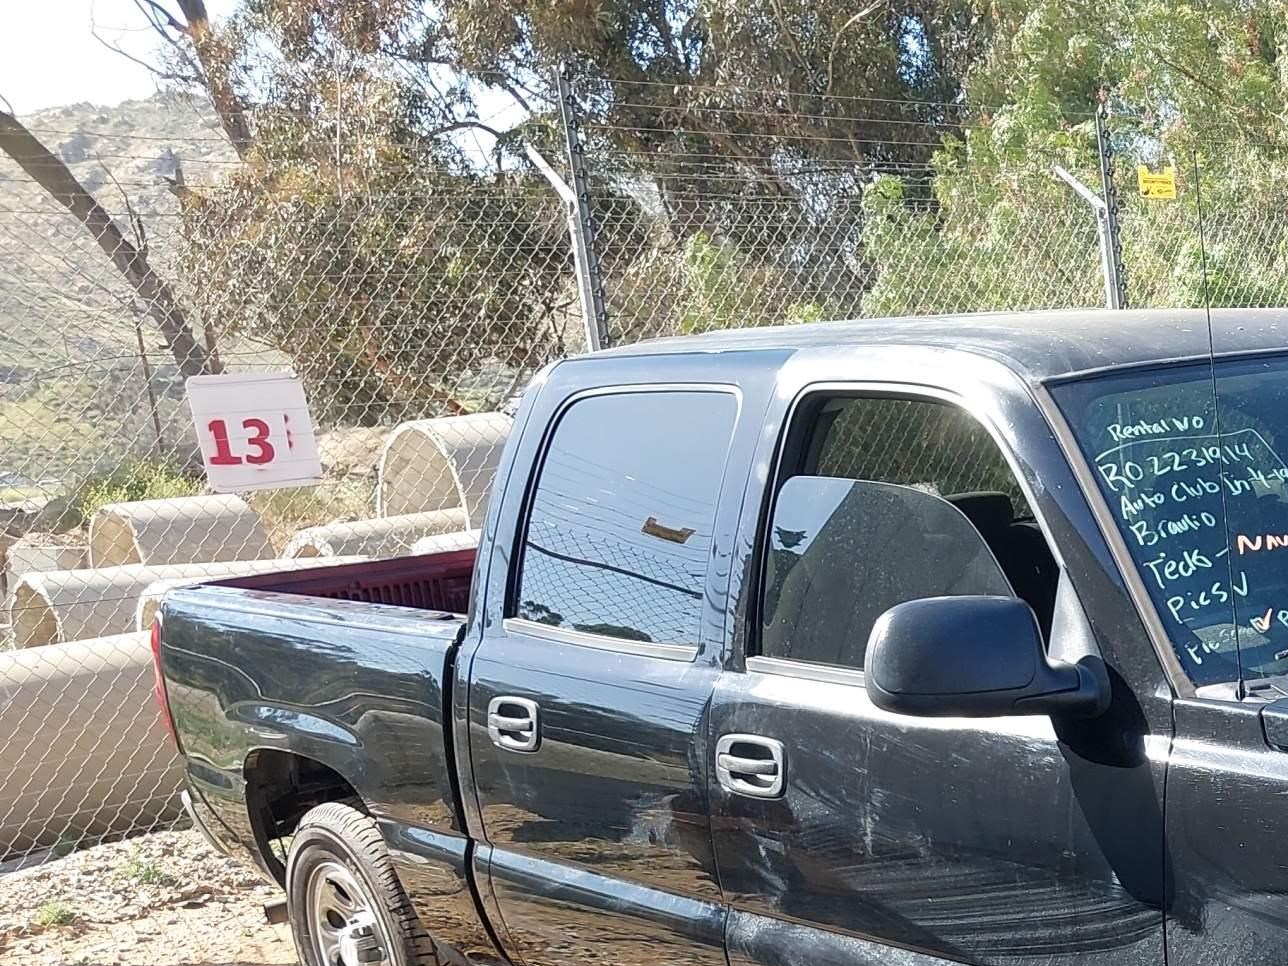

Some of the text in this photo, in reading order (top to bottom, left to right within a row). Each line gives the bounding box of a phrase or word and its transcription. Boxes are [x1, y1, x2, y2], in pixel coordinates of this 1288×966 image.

[208, 418, 276, 466] 13
[1108, 417, 1170, 442] Rental
[1098, 462, 1144, 491] RO
[1120, 490, 1165, 520] Auto
[1171, 478, 1220, 502] Club
